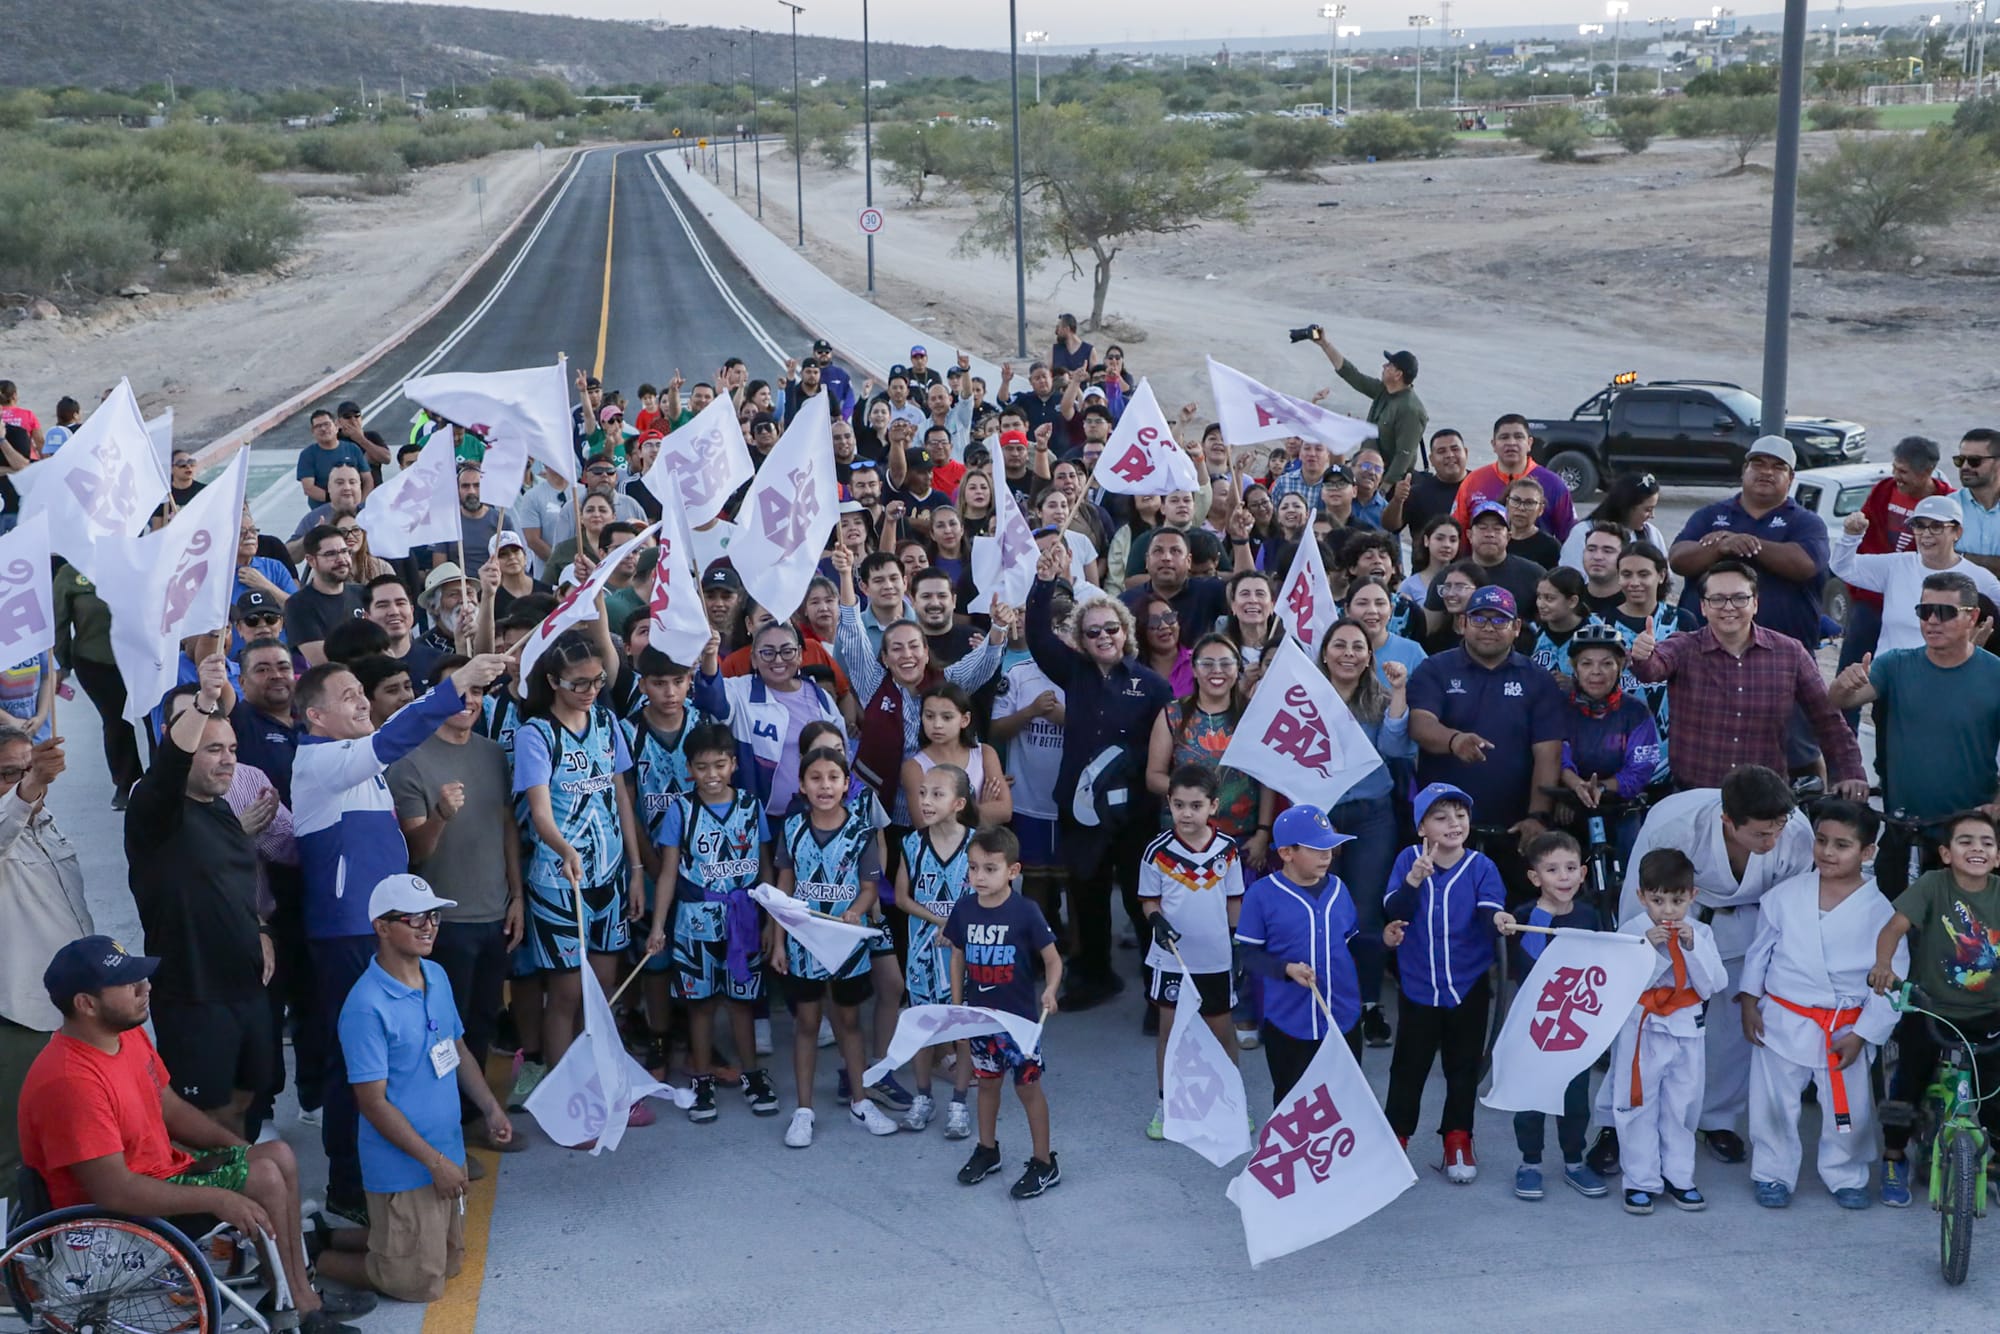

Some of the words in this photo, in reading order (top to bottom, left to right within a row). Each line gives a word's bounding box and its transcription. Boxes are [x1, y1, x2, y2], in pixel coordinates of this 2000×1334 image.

[865, 214, 877, 225] 30
[250, 593, 263, 604] C
[753, 720, 779, 743] LA
[1040, 737, 1063, 749] BETTE
[1261, 709, 1332, 770] PAZ
[564, 751, 588, 773] 30
[697, 831, 722, 856] 67
[699, 858, 761, 880] VIKINGOS
[918, 873, 938, 897] 47
[967, 924, 1009, 945] FAST
[1529, 966, 1585, 1052] PAZ
[1542, 995, 1603, 1052] LA
[1248, 1083, 1342, 1168] PAZ
[1248, 1140, 1330, 1200] LA
[66, 1233, 92, 1247] 222
